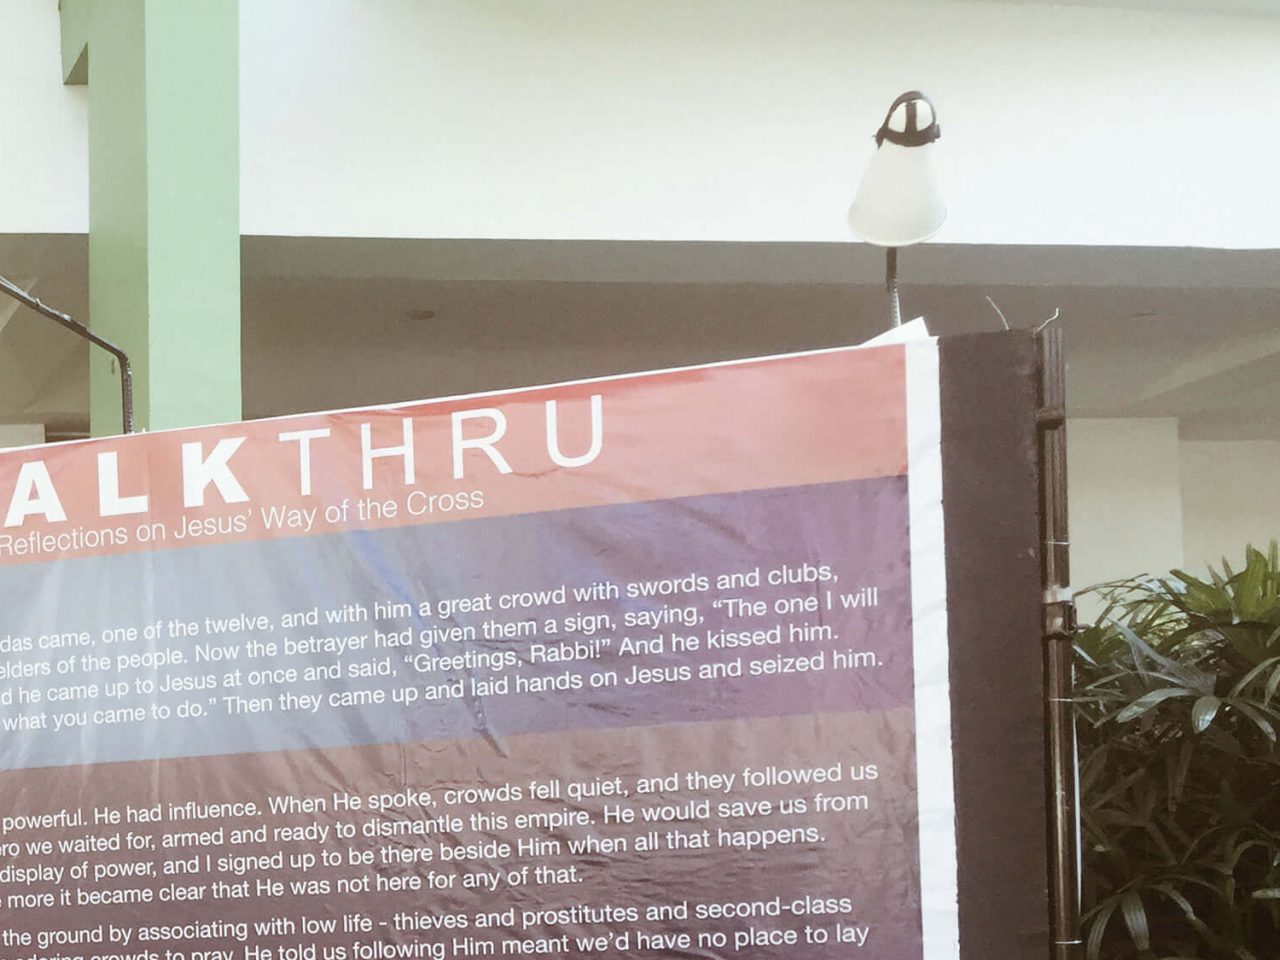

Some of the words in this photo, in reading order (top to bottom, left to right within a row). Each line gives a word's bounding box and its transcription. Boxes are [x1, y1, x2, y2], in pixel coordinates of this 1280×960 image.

[136, 523, 166, 542] on
[174, 508, 252, 539] Jesus'
[261, 505, 317, 532] Way
[325, 498, 349, 523] of
[357, 497, 398, 520] the
[407, 490, 484, 516] Cross
[38, 632, 95, 649] came,
[102, 628, 138, 643] one
[144, 620, 162, 639] of
[167, 619, 199, 638] the
[204, 614, 274, 634] twelve,
[281, 607, 318, 628] and
[325, 603, 367, 623] with
[374, 600, 412, 620] him
[419, 602, 432, 616] a
[438, 593, 492, 619] great
[499, 585, 566, 609] crowd
[573, 581, 619, 602] with
[626, 573, 709, 598] swords
[716, 567, 760, 590] and
[768, 562, 838, 585] clubs,
[2, 808, 88, 835] powerful.
[94, 807, 120, 824] He
[126, 804, 162, 823] had
[168, 802, 262, 820] influence.
[268, 796, 326, 814] When
[333, 792, 362, 811] He
[370, 788, 438, 813] spoke,
[444, 783, 522, 804] crowds
[528, 779, 560, 799] fell
[567, 777, 628, 802] quiet,
[636, 772, 678, 794] and
[686, 771, 736, 793] they
[742, 762, 842, 786] followed
[850, 764, 878, 780] us
[8, 893, 55, 908] more
[60, 888, 72, 906] it
[77, 888, 153, 905] became
[159, 883, 206, 902] clear
[211, 880, 250, 899] that
[256, 878, 284, 896] He
[290, 880, 330, 895] was
[337, 875, 370, 893] not
[376, 874, 422, 891] here
[427, 870, 456, 889] for
[463, 872, 500, 891] any
[507, 866, 528, 886] of
[534, 865, 583, 884] that.
